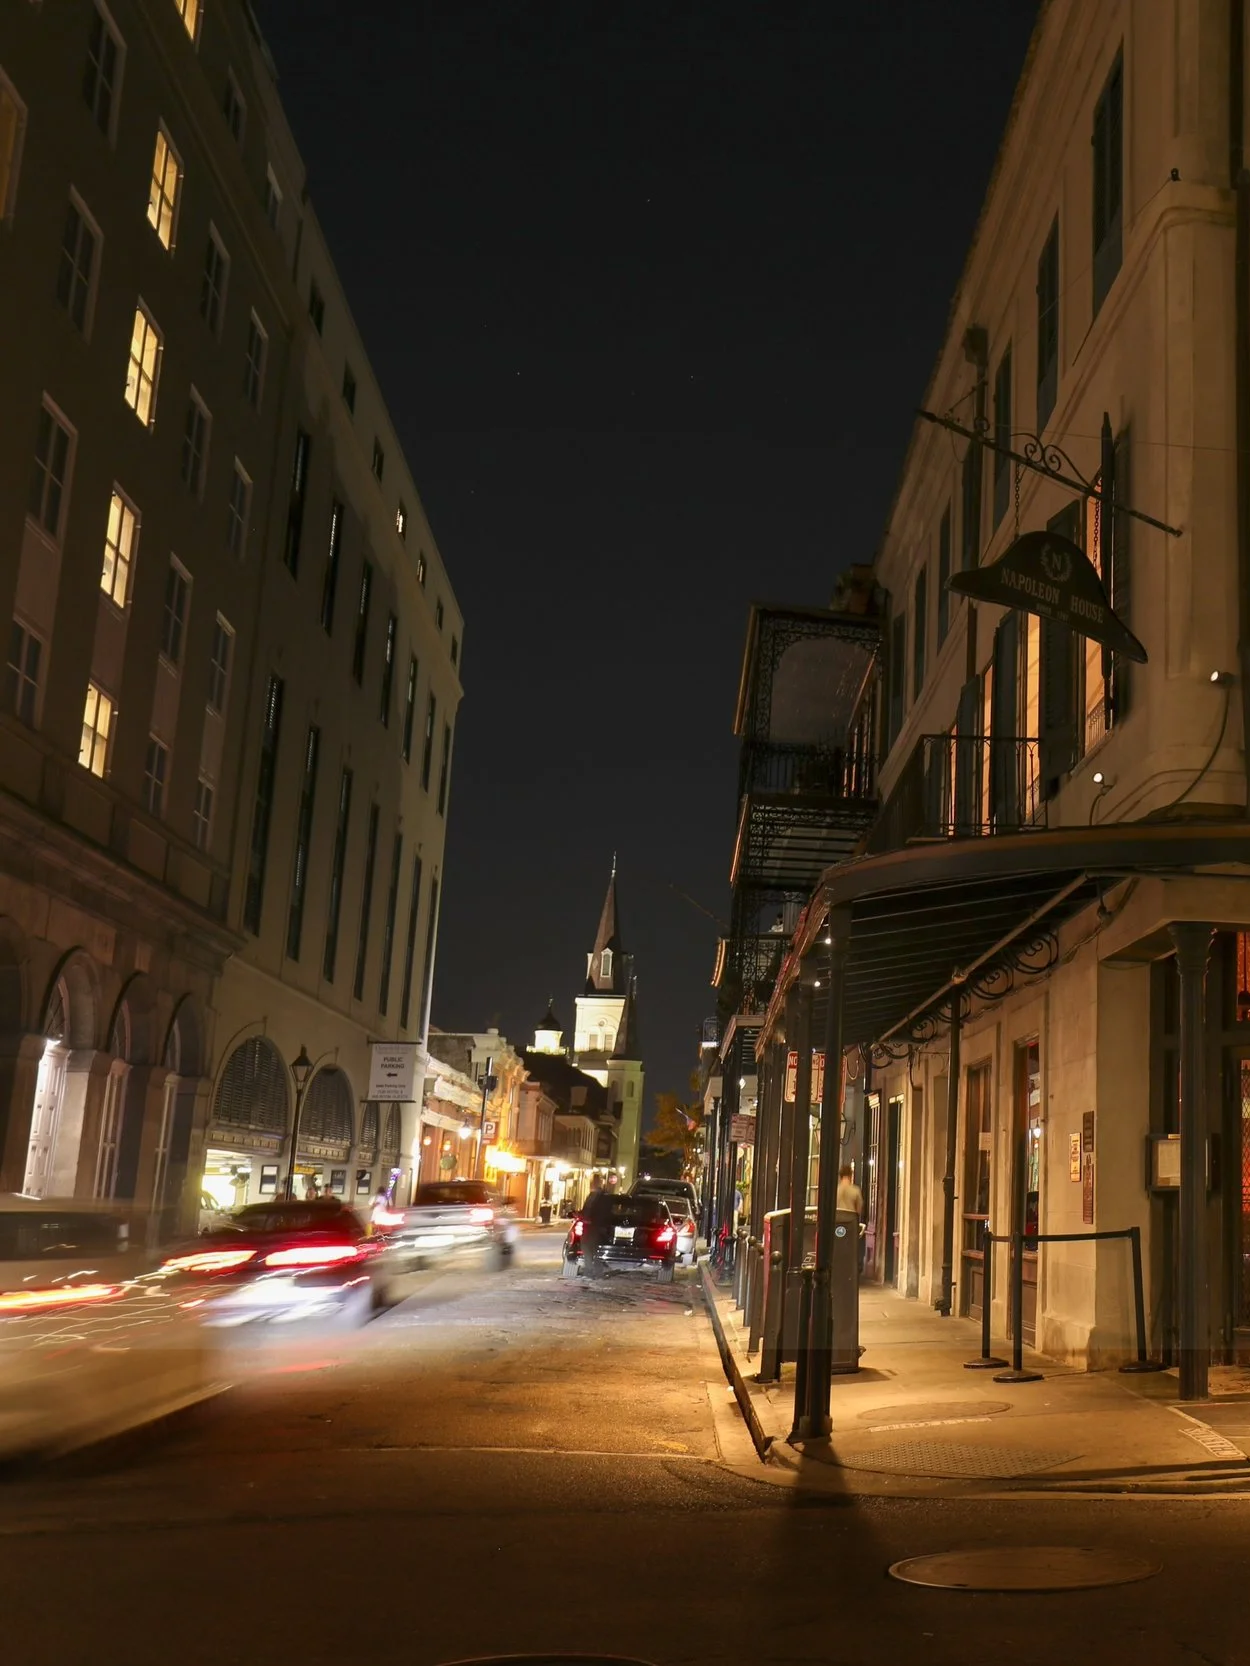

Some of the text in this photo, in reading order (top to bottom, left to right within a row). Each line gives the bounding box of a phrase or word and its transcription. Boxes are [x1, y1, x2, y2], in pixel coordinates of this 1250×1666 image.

[1052, 552, 1062, 570] N
[1000, 567, 1105, 624] NAPOLEON HOUSE
